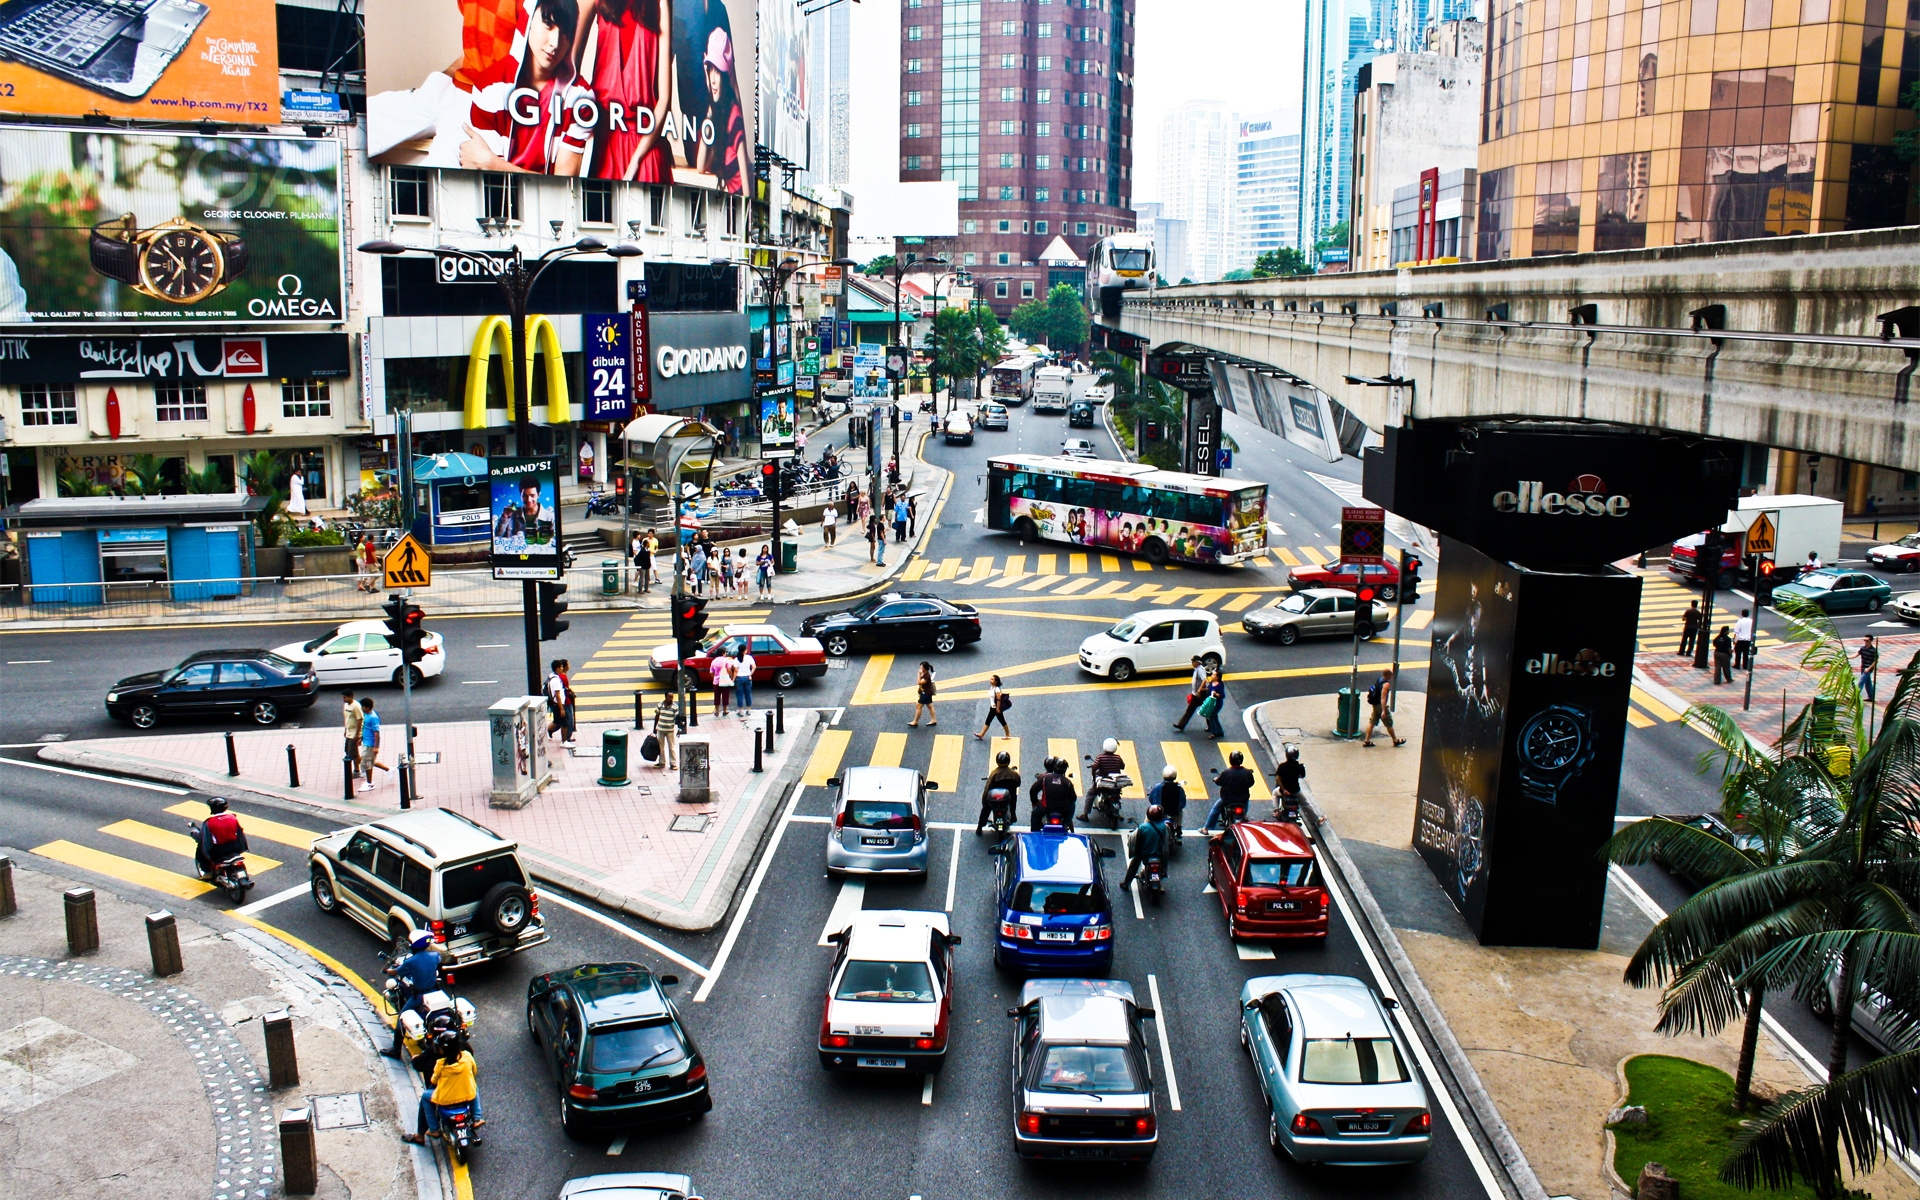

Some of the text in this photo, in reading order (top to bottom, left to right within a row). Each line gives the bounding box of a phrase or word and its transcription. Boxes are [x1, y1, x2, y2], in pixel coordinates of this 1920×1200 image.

[216, 38, 259, 54] COMPUTER
[209, 46, 257, 67] PERSONAL
[151, 97, 268, 112] www.hp.com.my/TX2
[508, 87, 715, 145] GIORDANO
[204, 210, 241, 219] GEORGE
[243, 211, 288, 219] CLOONEY.
[637, 284, 647, 293] 24
[248, 298, 335, 317] OMEGA
[634, 311, 645, 392] McDonald's
[592, 356, 625, 367] dibuka
[657, 346, 747, 378] GIORDANO
[593, 368, 625, 397] 24
[594, 398, 625, 414] jam
[503, 461, 551, 475] BRAND'S!
[1493, 480, 1631, 518] ellesse
[462, 513, 481, 522] POLIS
[495, 539, 513, 547] Enjoy
[1526, 652, 1616, 678] ellesse
